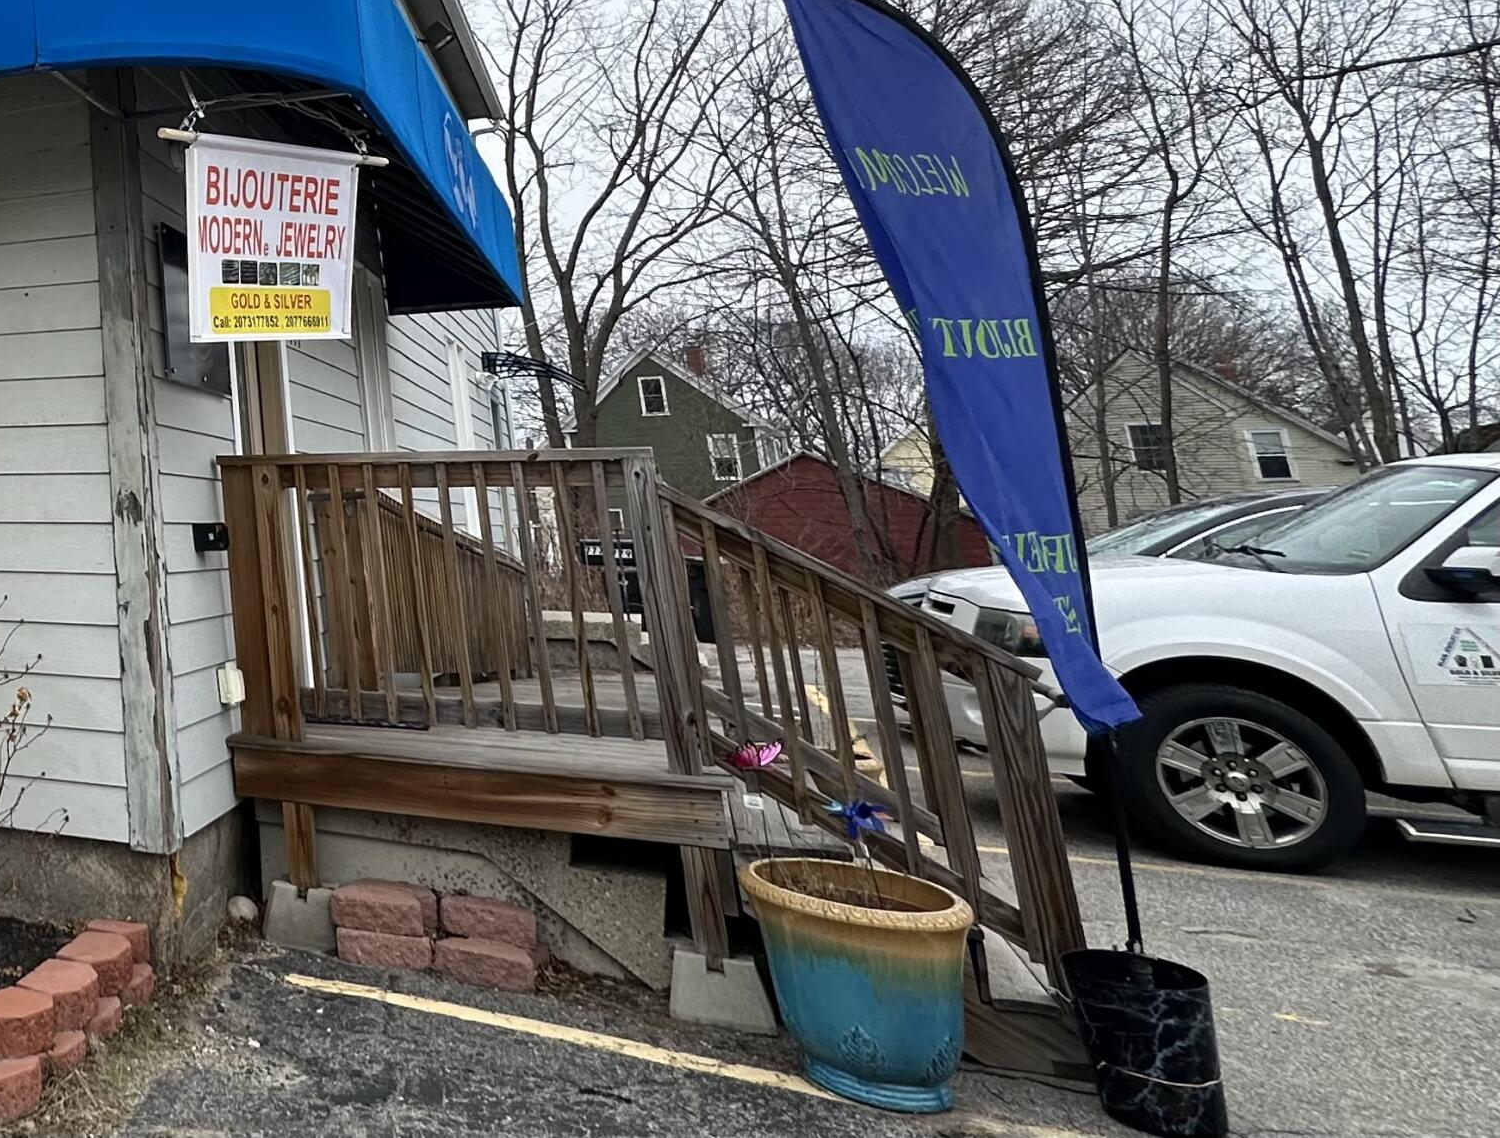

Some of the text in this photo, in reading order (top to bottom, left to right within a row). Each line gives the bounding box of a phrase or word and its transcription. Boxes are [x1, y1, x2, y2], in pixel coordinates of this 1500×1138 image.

[206, 165, 340, 216] BIJOUTERIE
[276, 222, 346, 259] JEWELRY
[231, 293, 312, 310] GOLD & SILVER
